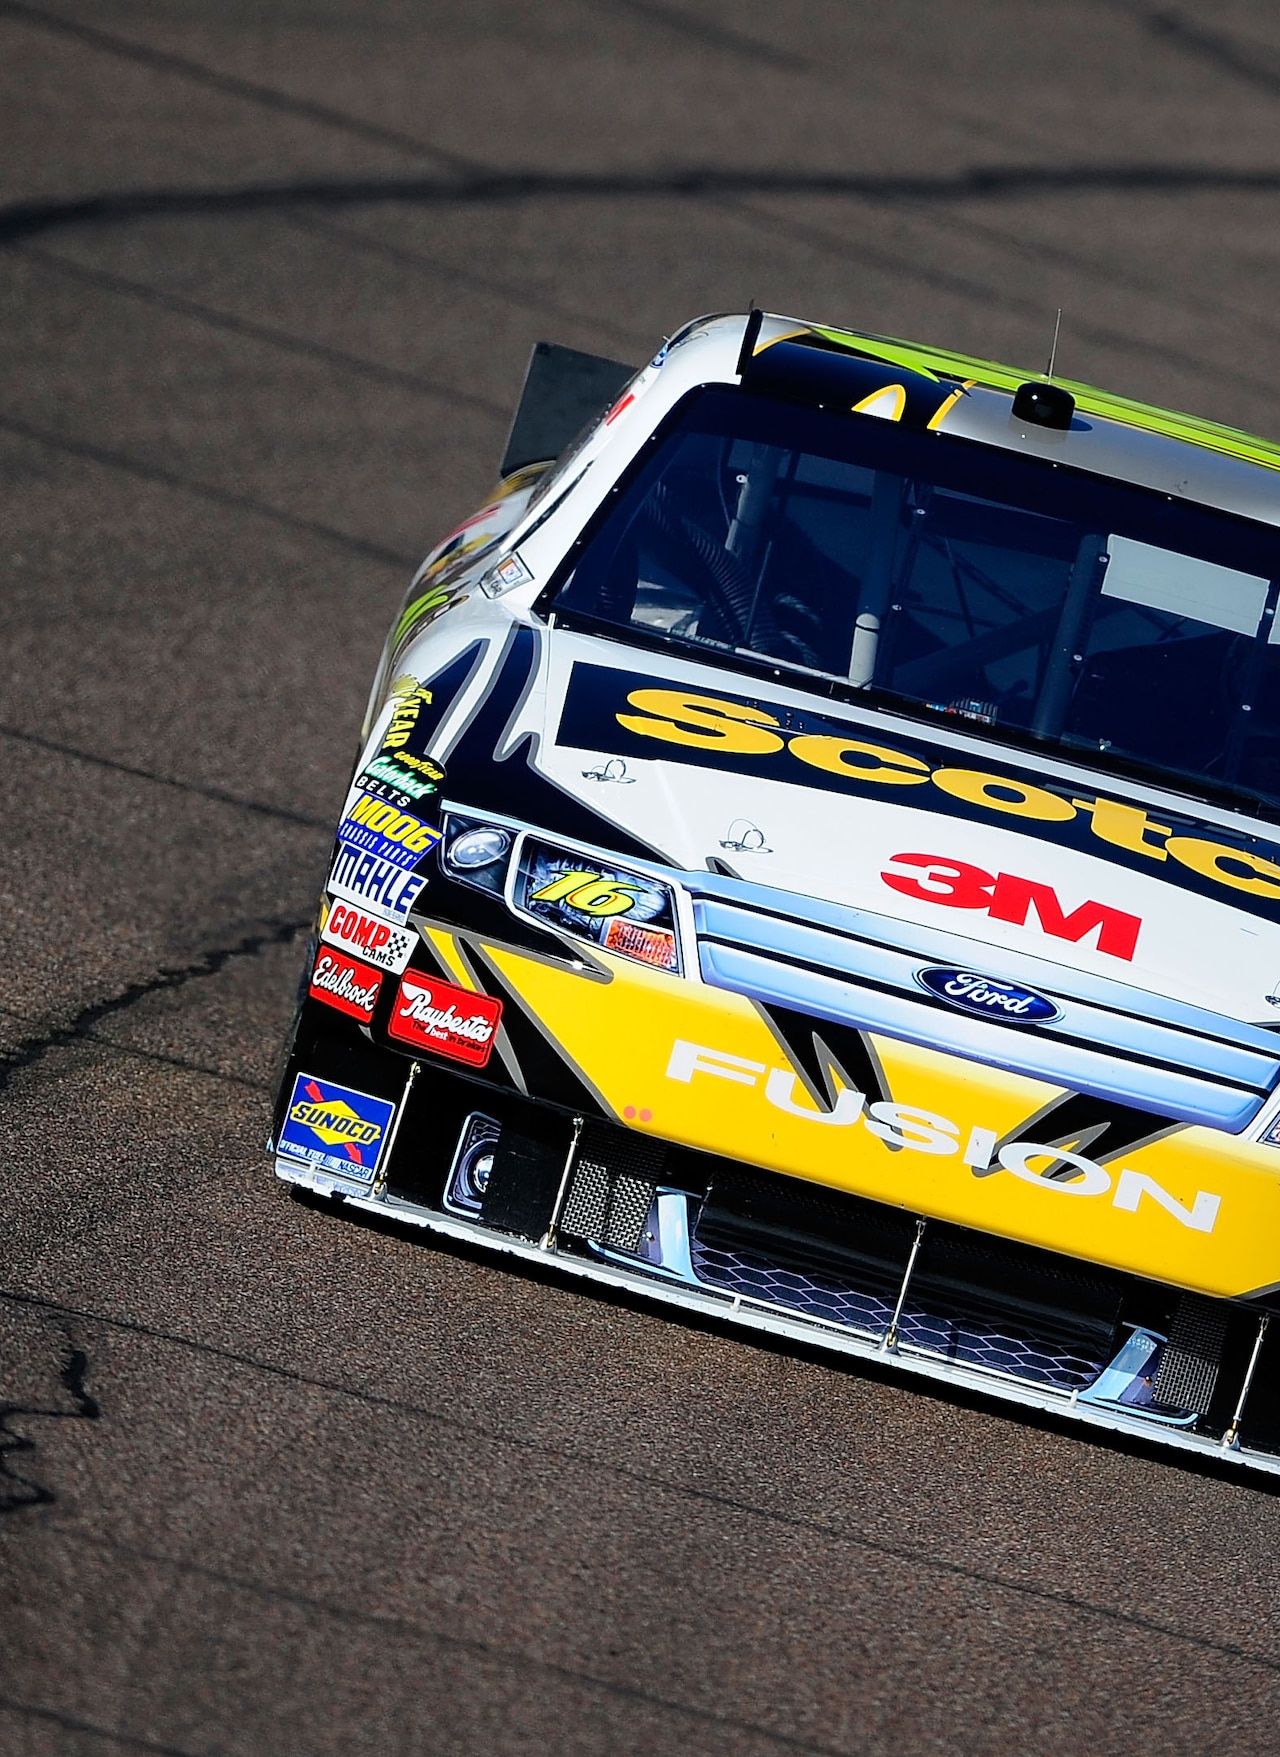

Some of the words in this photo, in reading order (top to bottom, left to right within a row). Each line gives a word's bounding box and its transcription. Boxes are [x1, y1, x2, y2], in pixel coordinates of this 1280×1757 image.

[356, 776, 410, 807] BELTS
[364, 756, 435, 799] Gatorback
[347, 794, 443, 853] MOOG
[332, 844, 424, 914] MAHLE
[531, 870, 650, 918] 16
[329, 905, 391, 950] COMP
[880, 852, 1142, 962] 3M
[362, 945, 395, 967] CAMS
[312, 956, 379, 1012] Edelbrock
[946, 970, 1038, 1018] Ford
[400, 981, 493, 1042] Raybestos
[430, 1027, 448, 1040] best
[293, 1104, 377, 1142] SUNOCO
[665, 1038, 1221, 1233] FUSION
